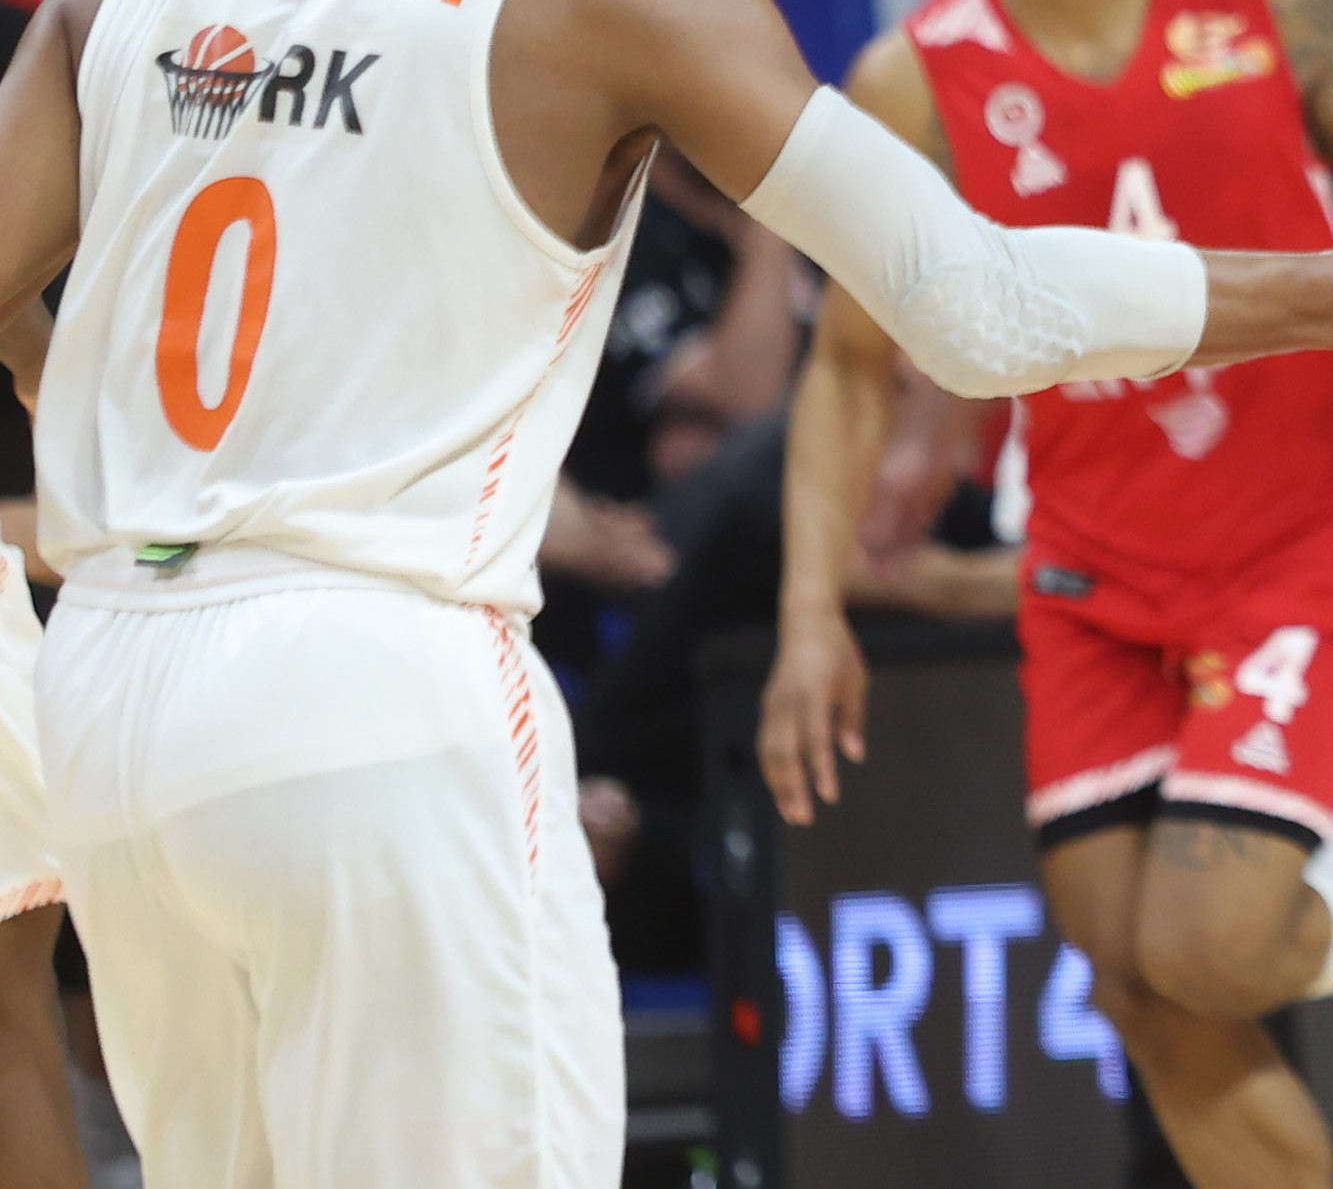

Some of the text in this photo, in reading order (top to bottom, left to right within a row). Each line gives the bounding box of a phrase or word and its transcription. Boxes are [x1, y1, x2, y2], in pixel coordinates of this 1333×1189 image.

[1106, 156, 1181, 241] 4
[154, 175, 277, 453] 0
[1234, 624, 1320, 726] 4
